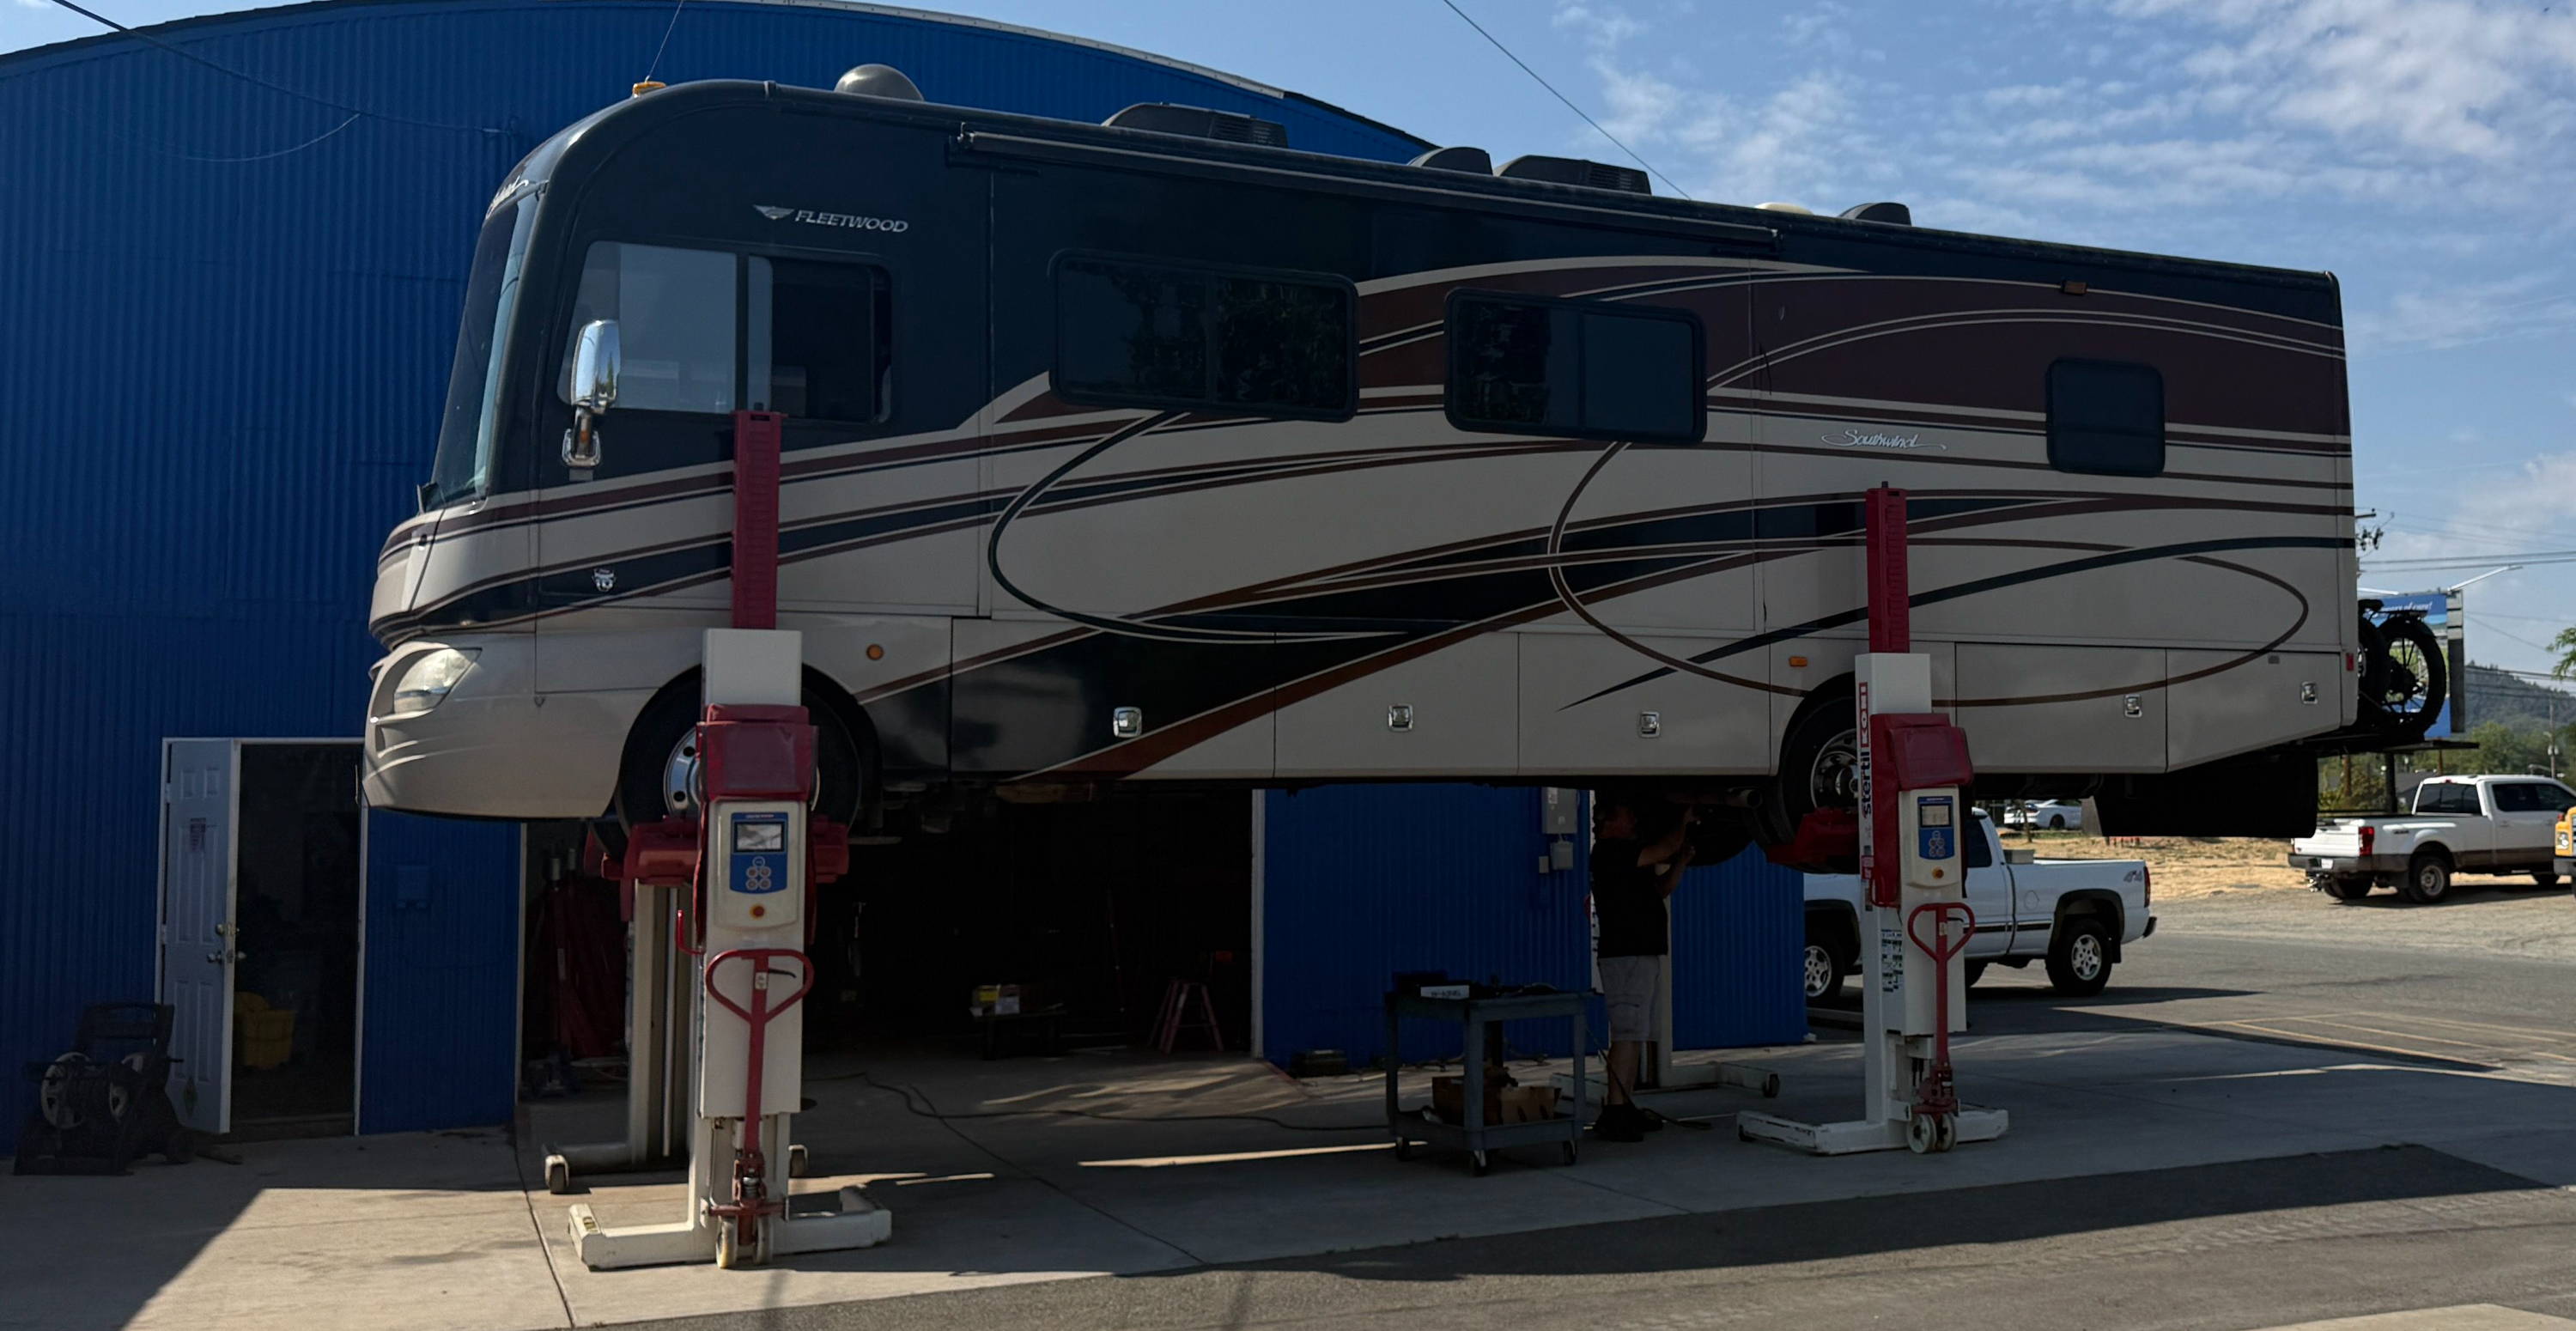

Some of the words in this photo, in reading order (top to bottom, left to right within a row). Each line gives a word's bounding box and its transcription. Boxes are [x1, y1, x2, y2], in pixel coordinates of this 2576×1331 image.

[794, 210, 909, 233] FLEETWOOD
[1821, 429, 1947, 451] Southwind
[1861, 752, 1871, 817] stertil
